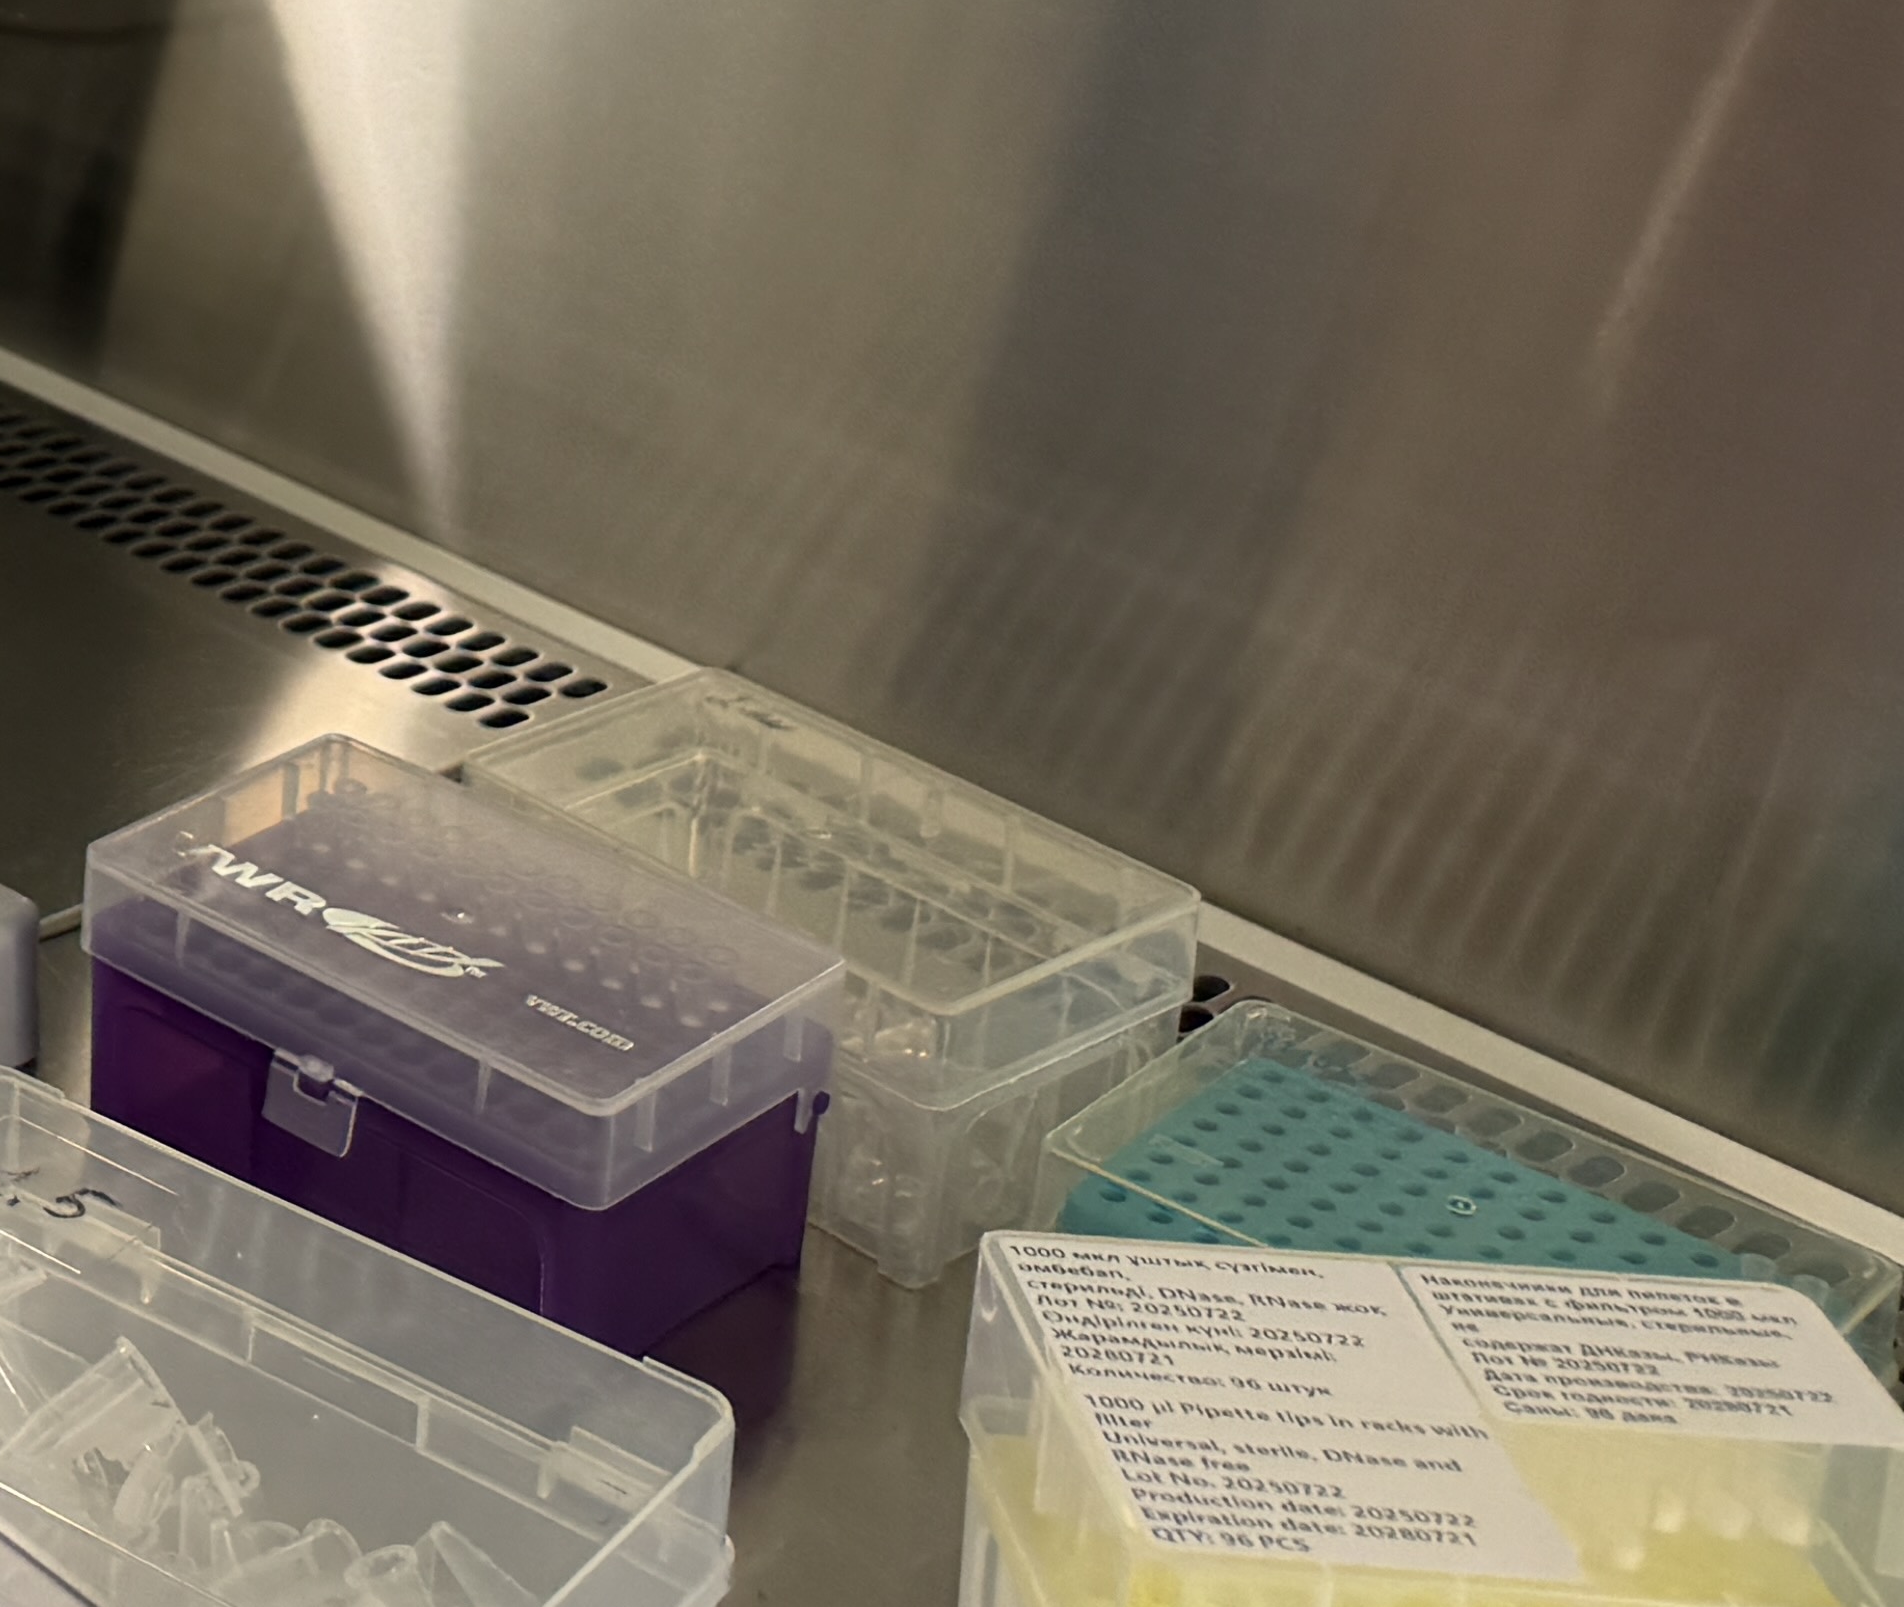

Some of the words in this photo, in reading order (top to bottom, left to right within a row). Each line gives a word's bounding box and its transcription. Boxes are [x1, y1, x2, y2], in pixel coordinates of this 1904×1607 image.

[1009, 1245, 1066, 1259] 1000
[1131, 1301, 1246, 1323] 20250722
[1249, 1293, 1328, 1311] RNase
[1248, 1327, 1365, 1348] 20250722
[1084, 1393, 1145, 1412] 1000
[1178, 1401, 1271, 1422] Pipette
[1275, 1410, 1325, 1428] tips
[1327, 1413, 1354, 1429] in
[1360, 1419, 1427, 1435] racks
[1429, 1423, 1490, 1440] with
[1094, 1412, 1153, 1429] filter
[1110, 1448, 1195, 1469] RNase
[1200, 1456, 1251, 1472] free
[1321, 1448, 1409, 1468] DNase
[1412, 1457, 1463, 1473] and
[1120, 1466, 1164, 1484] Lot
[1221, 1476, 1346, 1499] 20250722
[1130, 1486, 1274, 1512] Production
[1281, 1500, 1347, 1518] date:
[1350, 1505, 1477, 1528] 20250722
[1139, 1505, 1274, 1530] Expiration
[1280, 1517, 1347, 1536] date:
[1350, 1521, 1478, 1547] 20280721
[1219, 1531, 1254, 1547] 96
[1258, 1534, 1311, 1553] PCS
